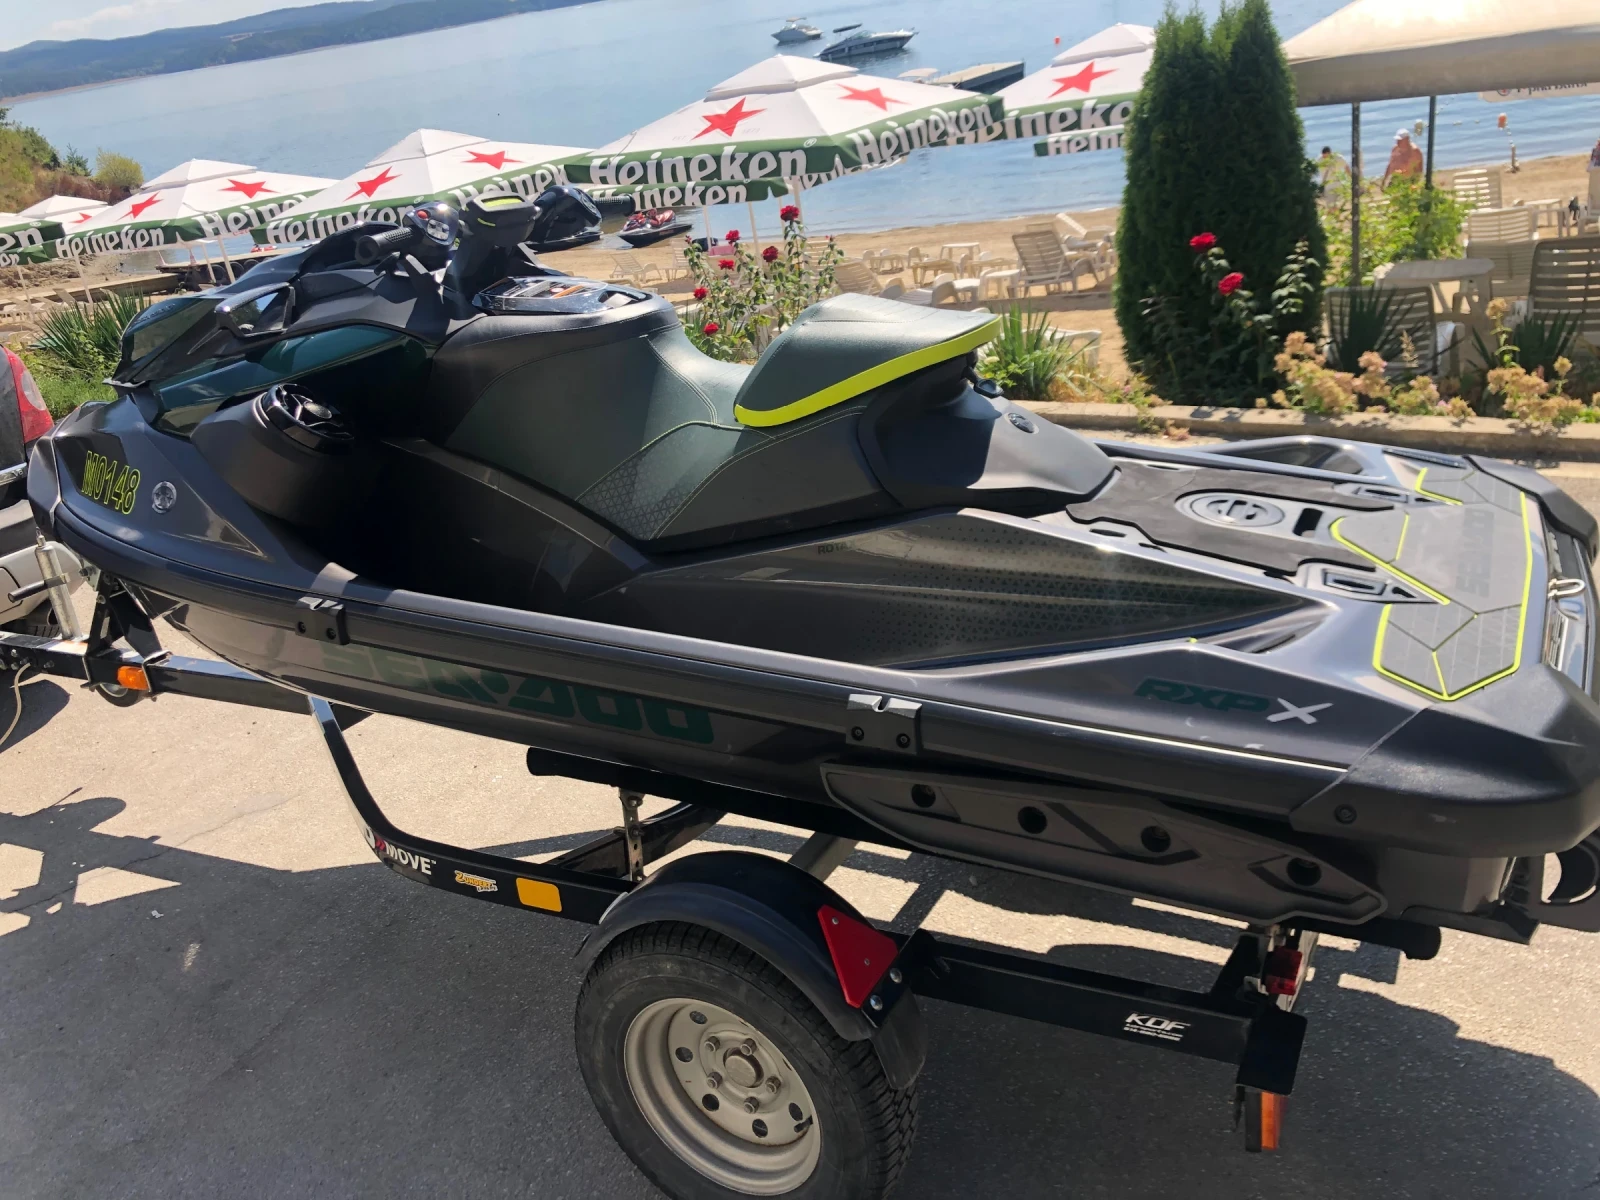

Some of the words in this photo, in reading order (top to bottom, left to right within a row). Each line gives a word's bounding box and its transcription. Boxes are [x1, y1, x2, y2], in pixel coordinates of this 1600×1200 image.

[590, 145, 808, 186] Heineken
[55, 225, 165, 259] Heineken
[1124, 1012, 1192, 1031] KDF
